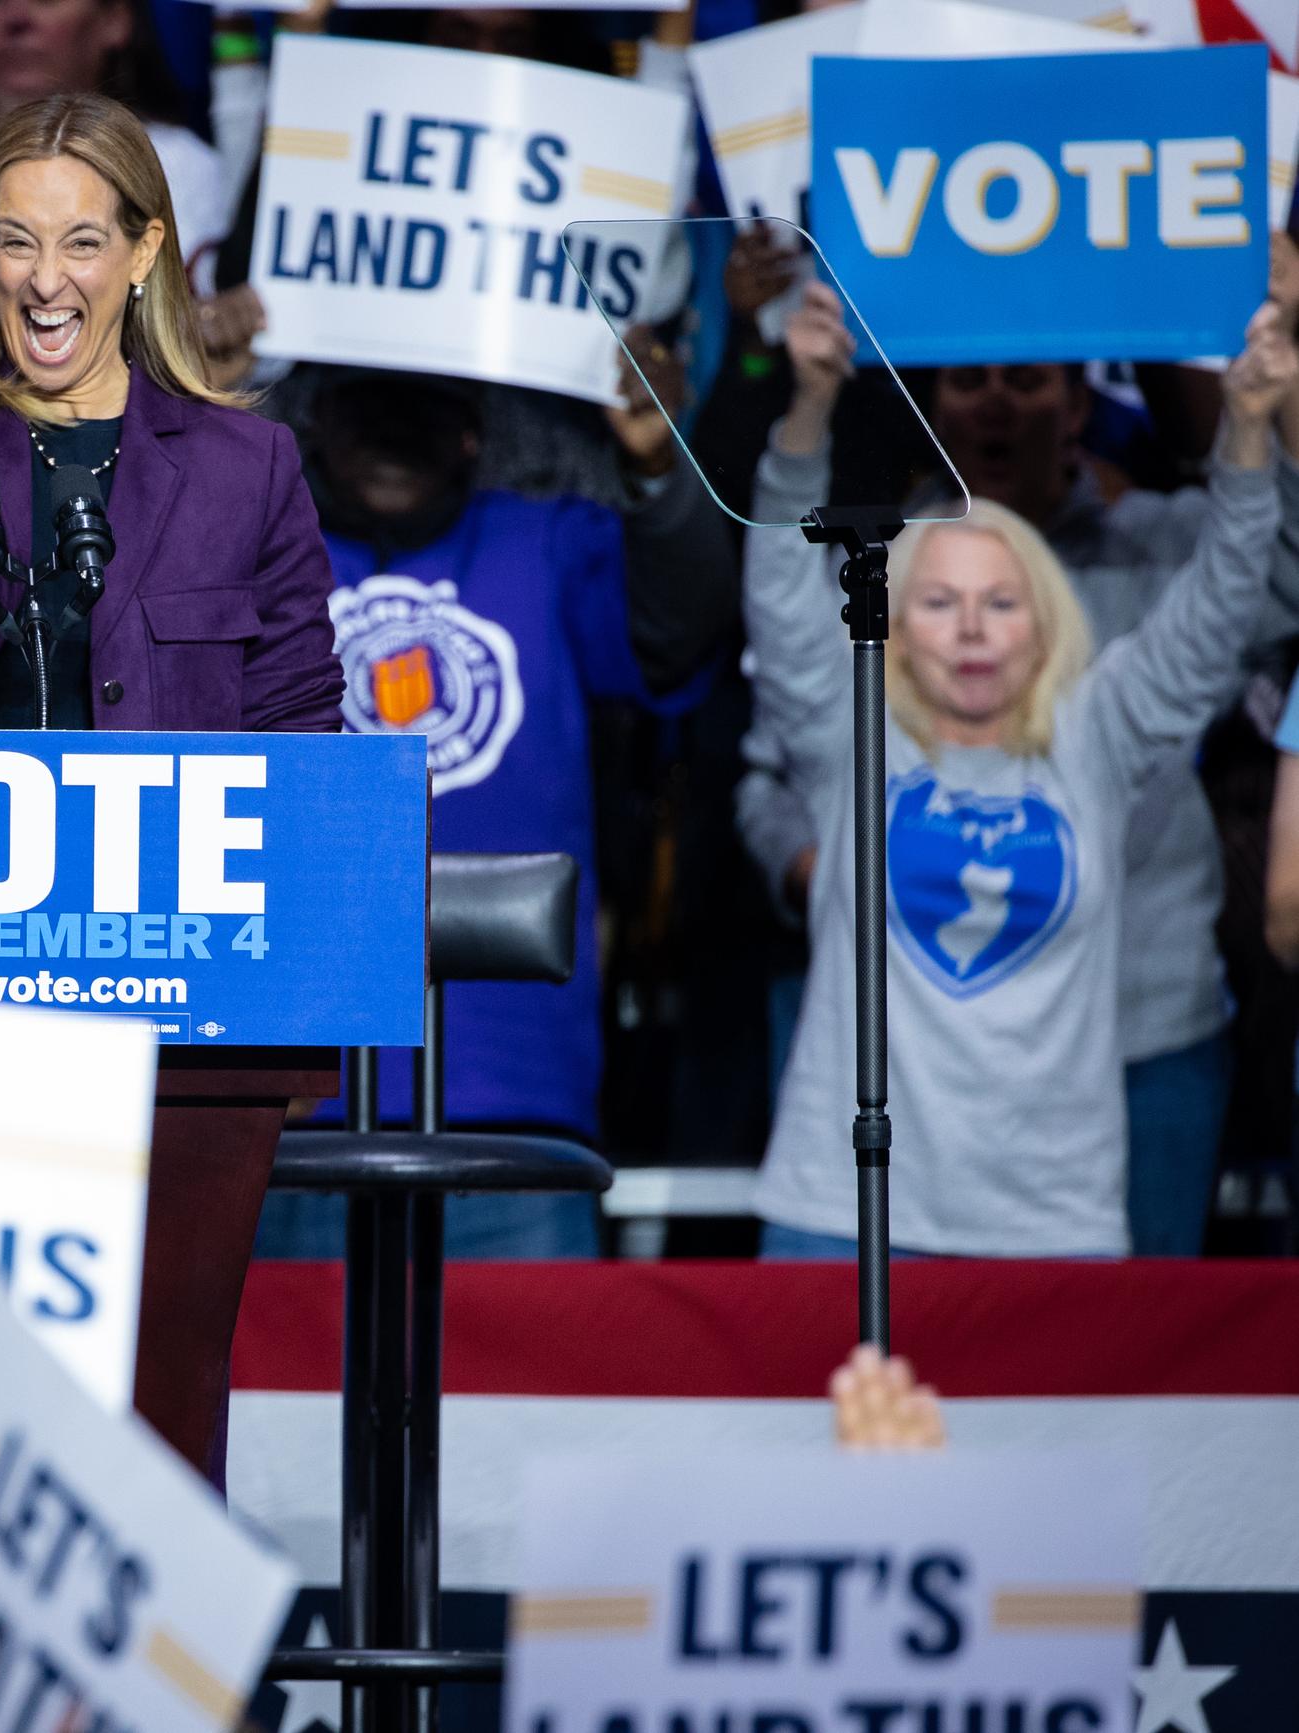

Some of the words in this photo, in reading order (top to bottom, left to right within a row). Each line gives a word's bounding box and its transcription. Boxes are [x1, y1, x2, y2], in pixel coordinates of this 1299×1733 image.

[834, 136, 1251, 257] VOTE
[269, 207, 448, 293] LAND
[470, 220, 645, 320] THIS
[232, 916, 269, 960] 4
[672, 1546, 970, 1668] LET'S
